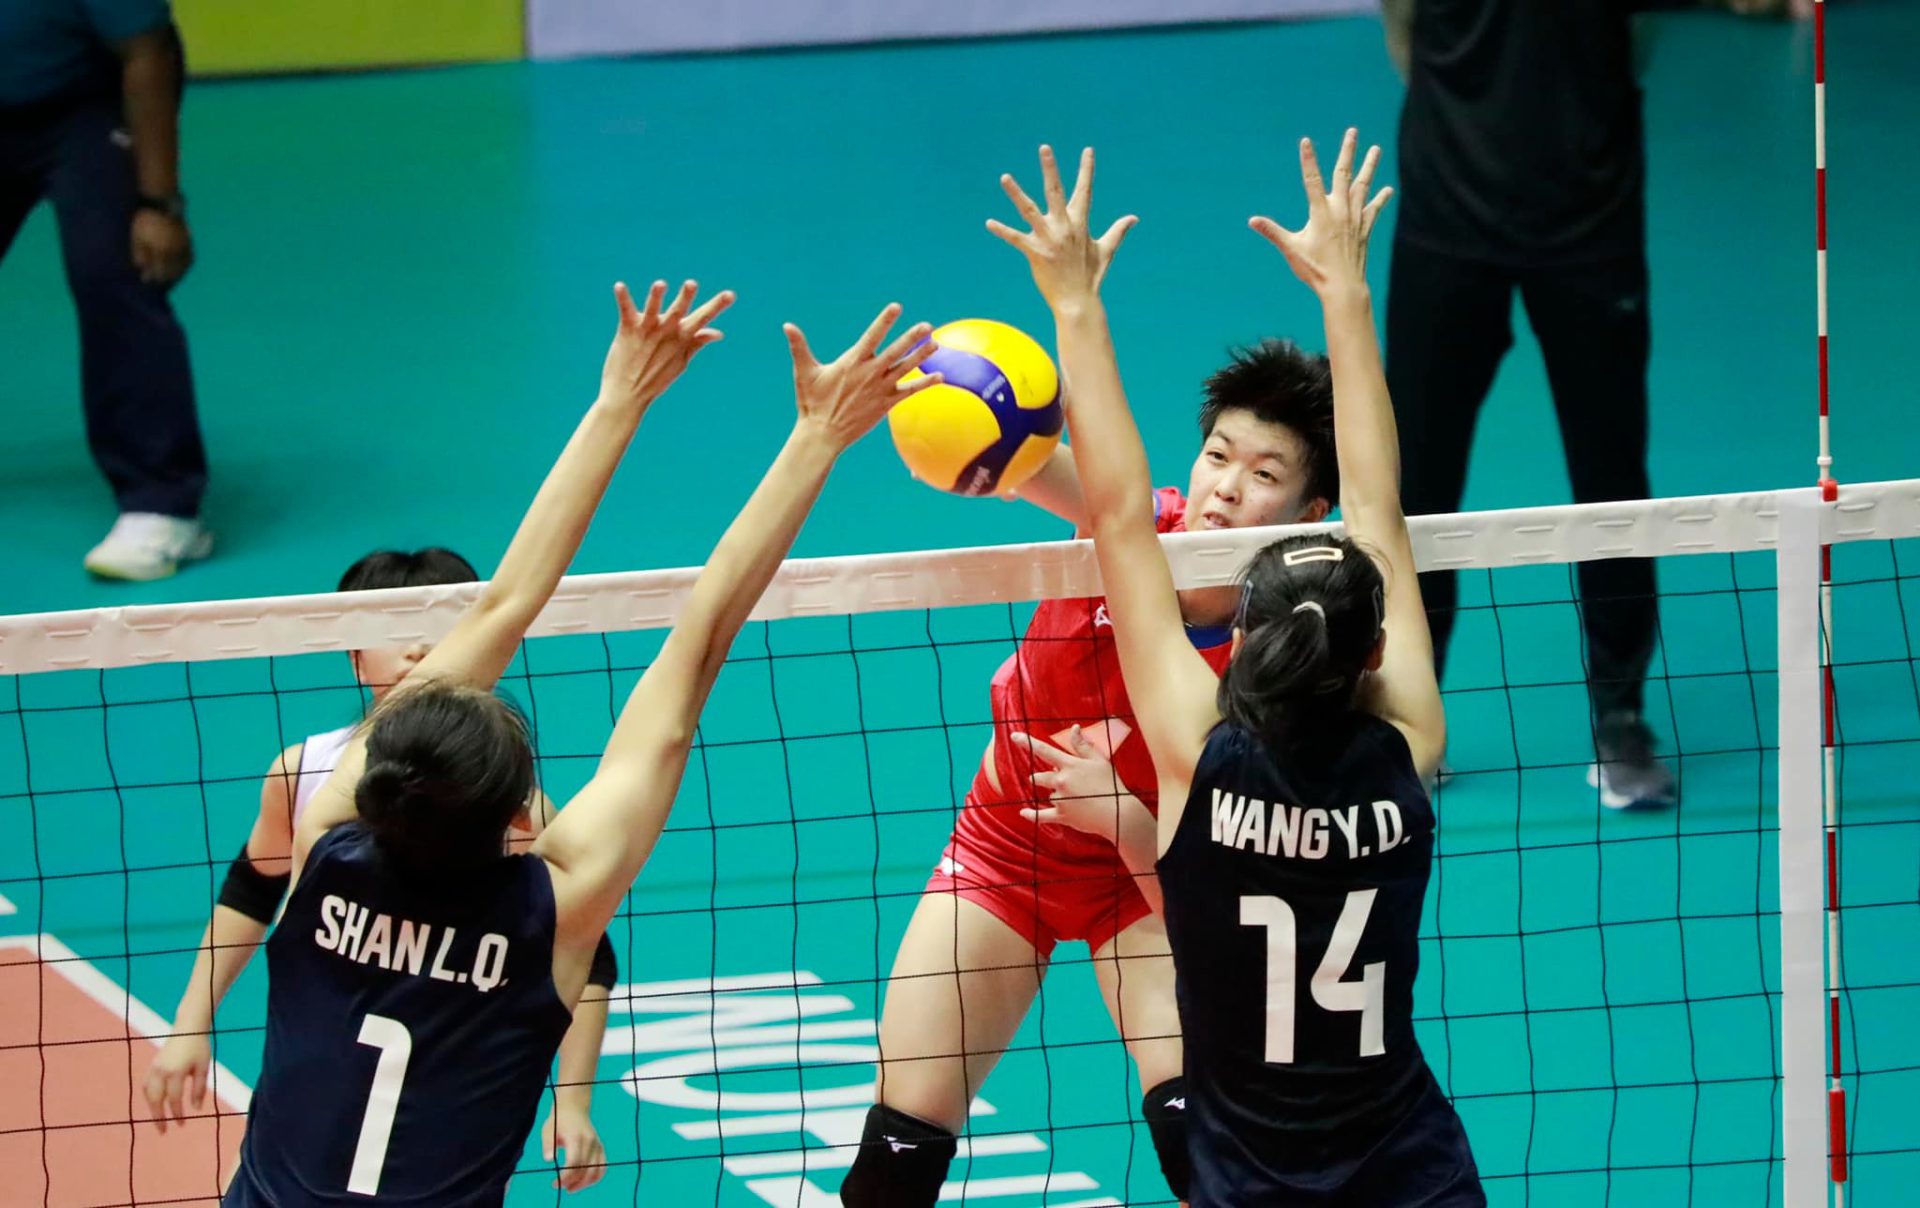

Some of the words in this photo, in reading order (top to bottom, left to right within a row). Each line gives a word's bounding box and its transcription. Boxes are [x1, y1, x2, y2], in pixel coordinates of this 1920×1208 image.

[1211, 787, 1325, 860] WANG
[314, 894, 432, 977] SHAN
[1239, 888, 1386, 1064] 14
[346, 1012, 413, 1197] 1
